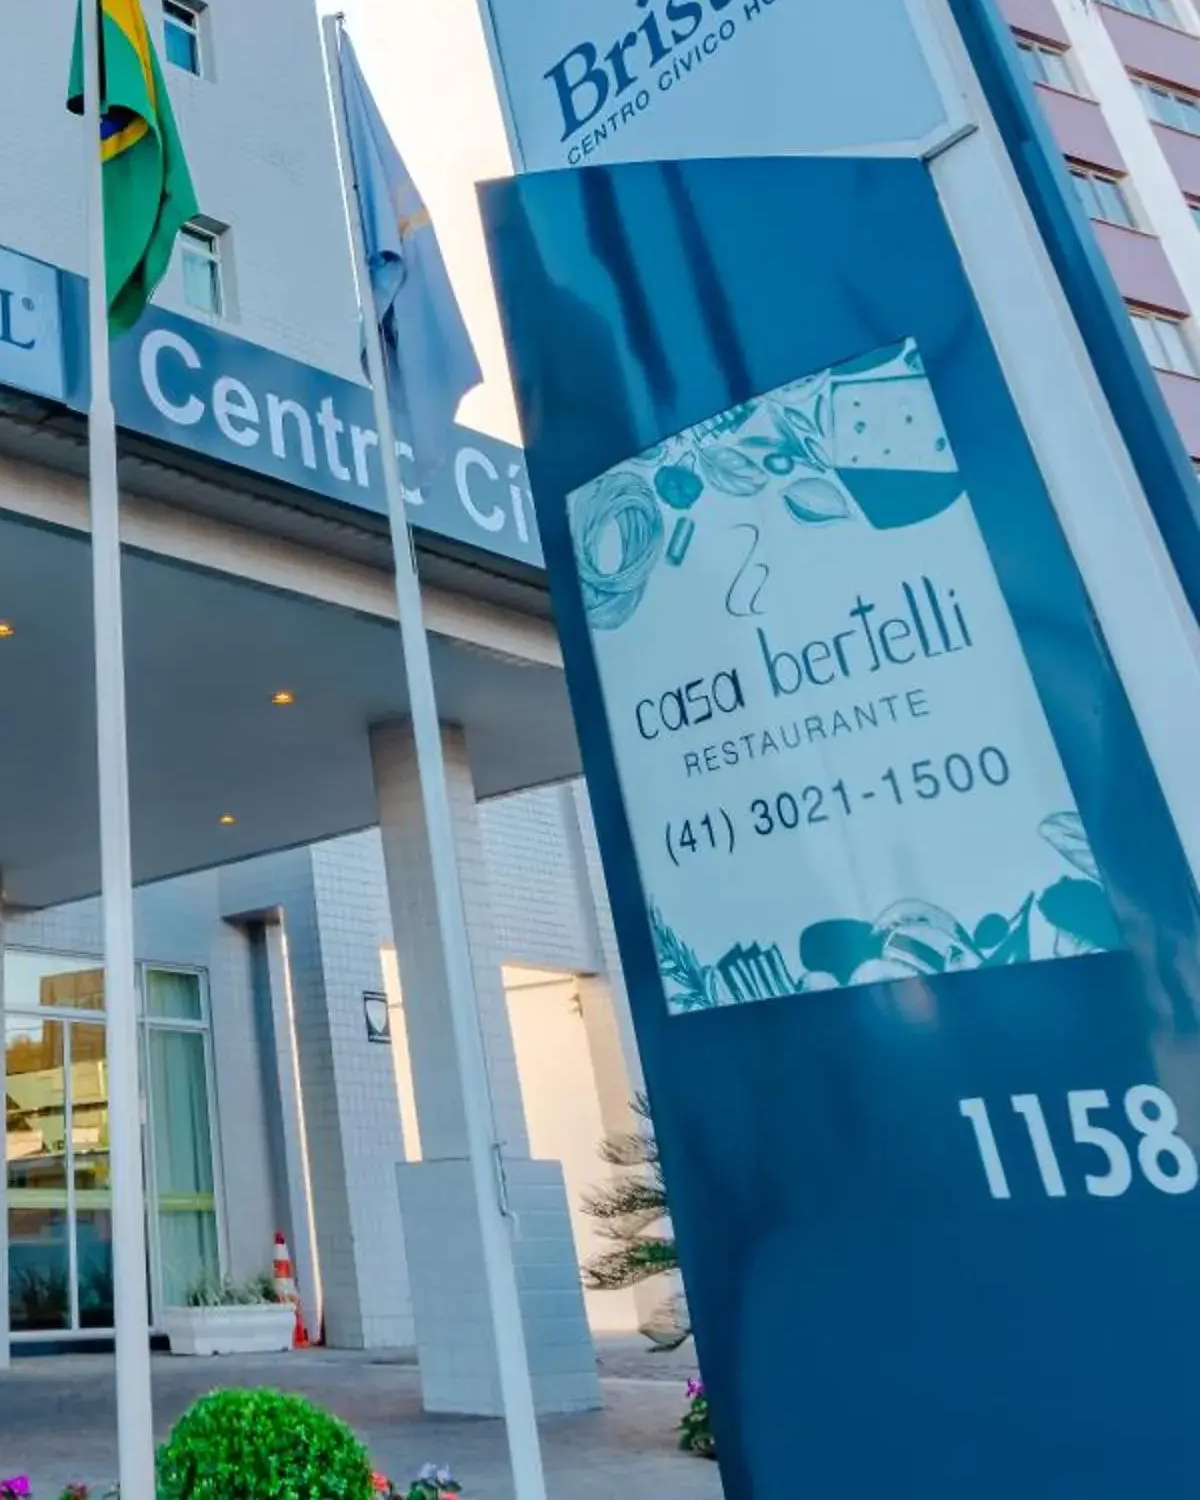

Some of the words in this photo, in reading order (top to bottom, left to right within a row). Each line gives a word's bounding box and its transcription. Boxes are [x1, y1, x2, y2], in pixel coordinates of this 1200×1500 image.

[567, 89, 650, 166] CENTRO
[657, 19, 736, 92] CÍVICO
[635, 668, 745, 740] casa
[757, 575, 973, 697] bertelli
[683, 688, 931, 777] RESTAURANTE
[665, 807, 735, 867] (41)
[750, 745, 1010, 836] 3021-1500
[959, 1083, 1199, 1199] 1158
